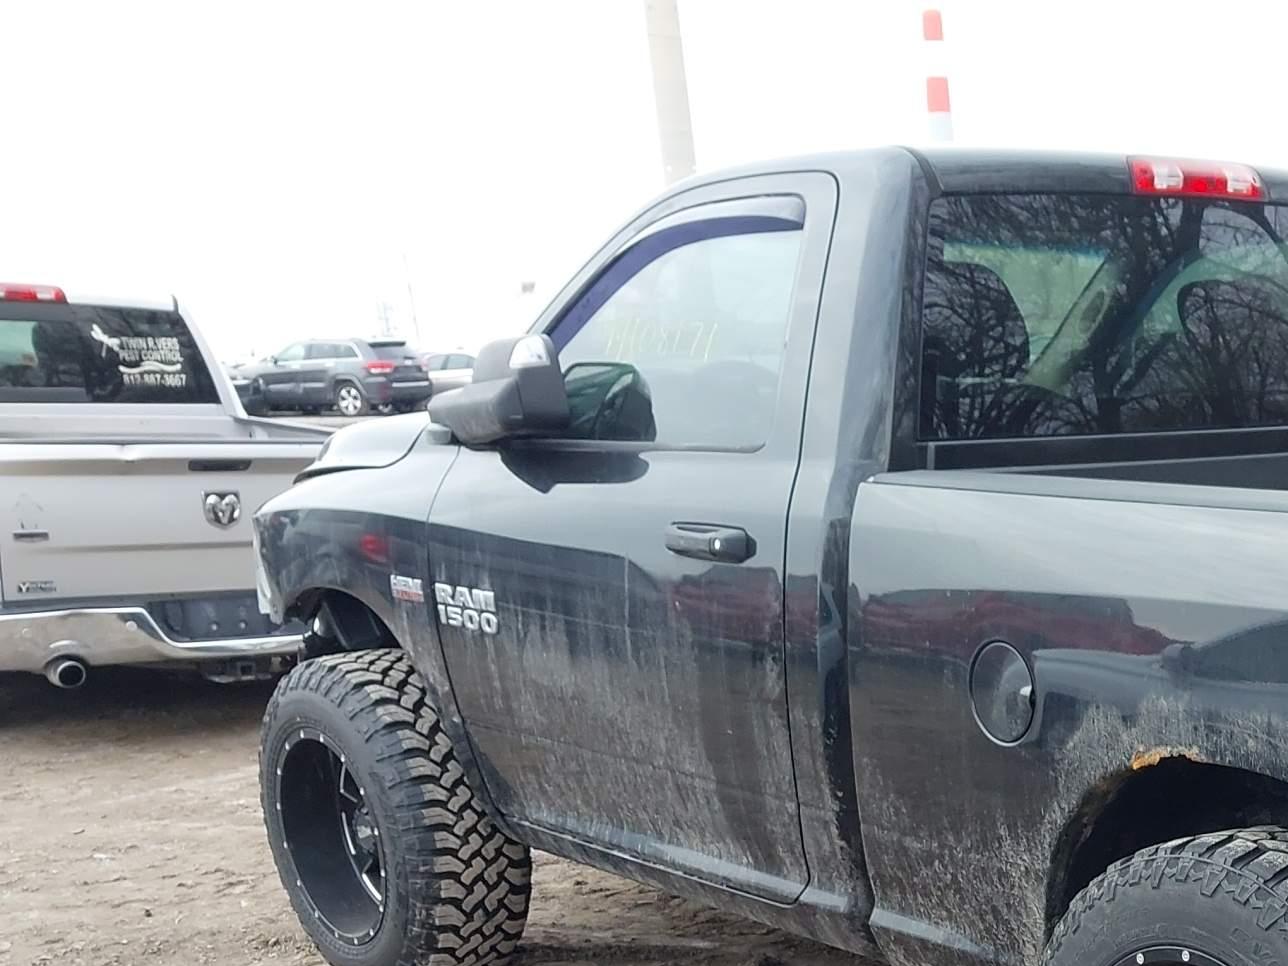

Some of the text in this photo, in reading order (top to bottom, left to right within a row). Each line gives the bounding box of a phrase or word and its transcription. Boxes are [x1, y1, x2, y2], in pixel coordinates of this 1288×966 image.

[120, 336, 147, 350] TWIN
[119, 350, 184, 363] PEST CONTROL
[434, 582, 497, 612] RAM
[437, 603, 498, 634] 1500
